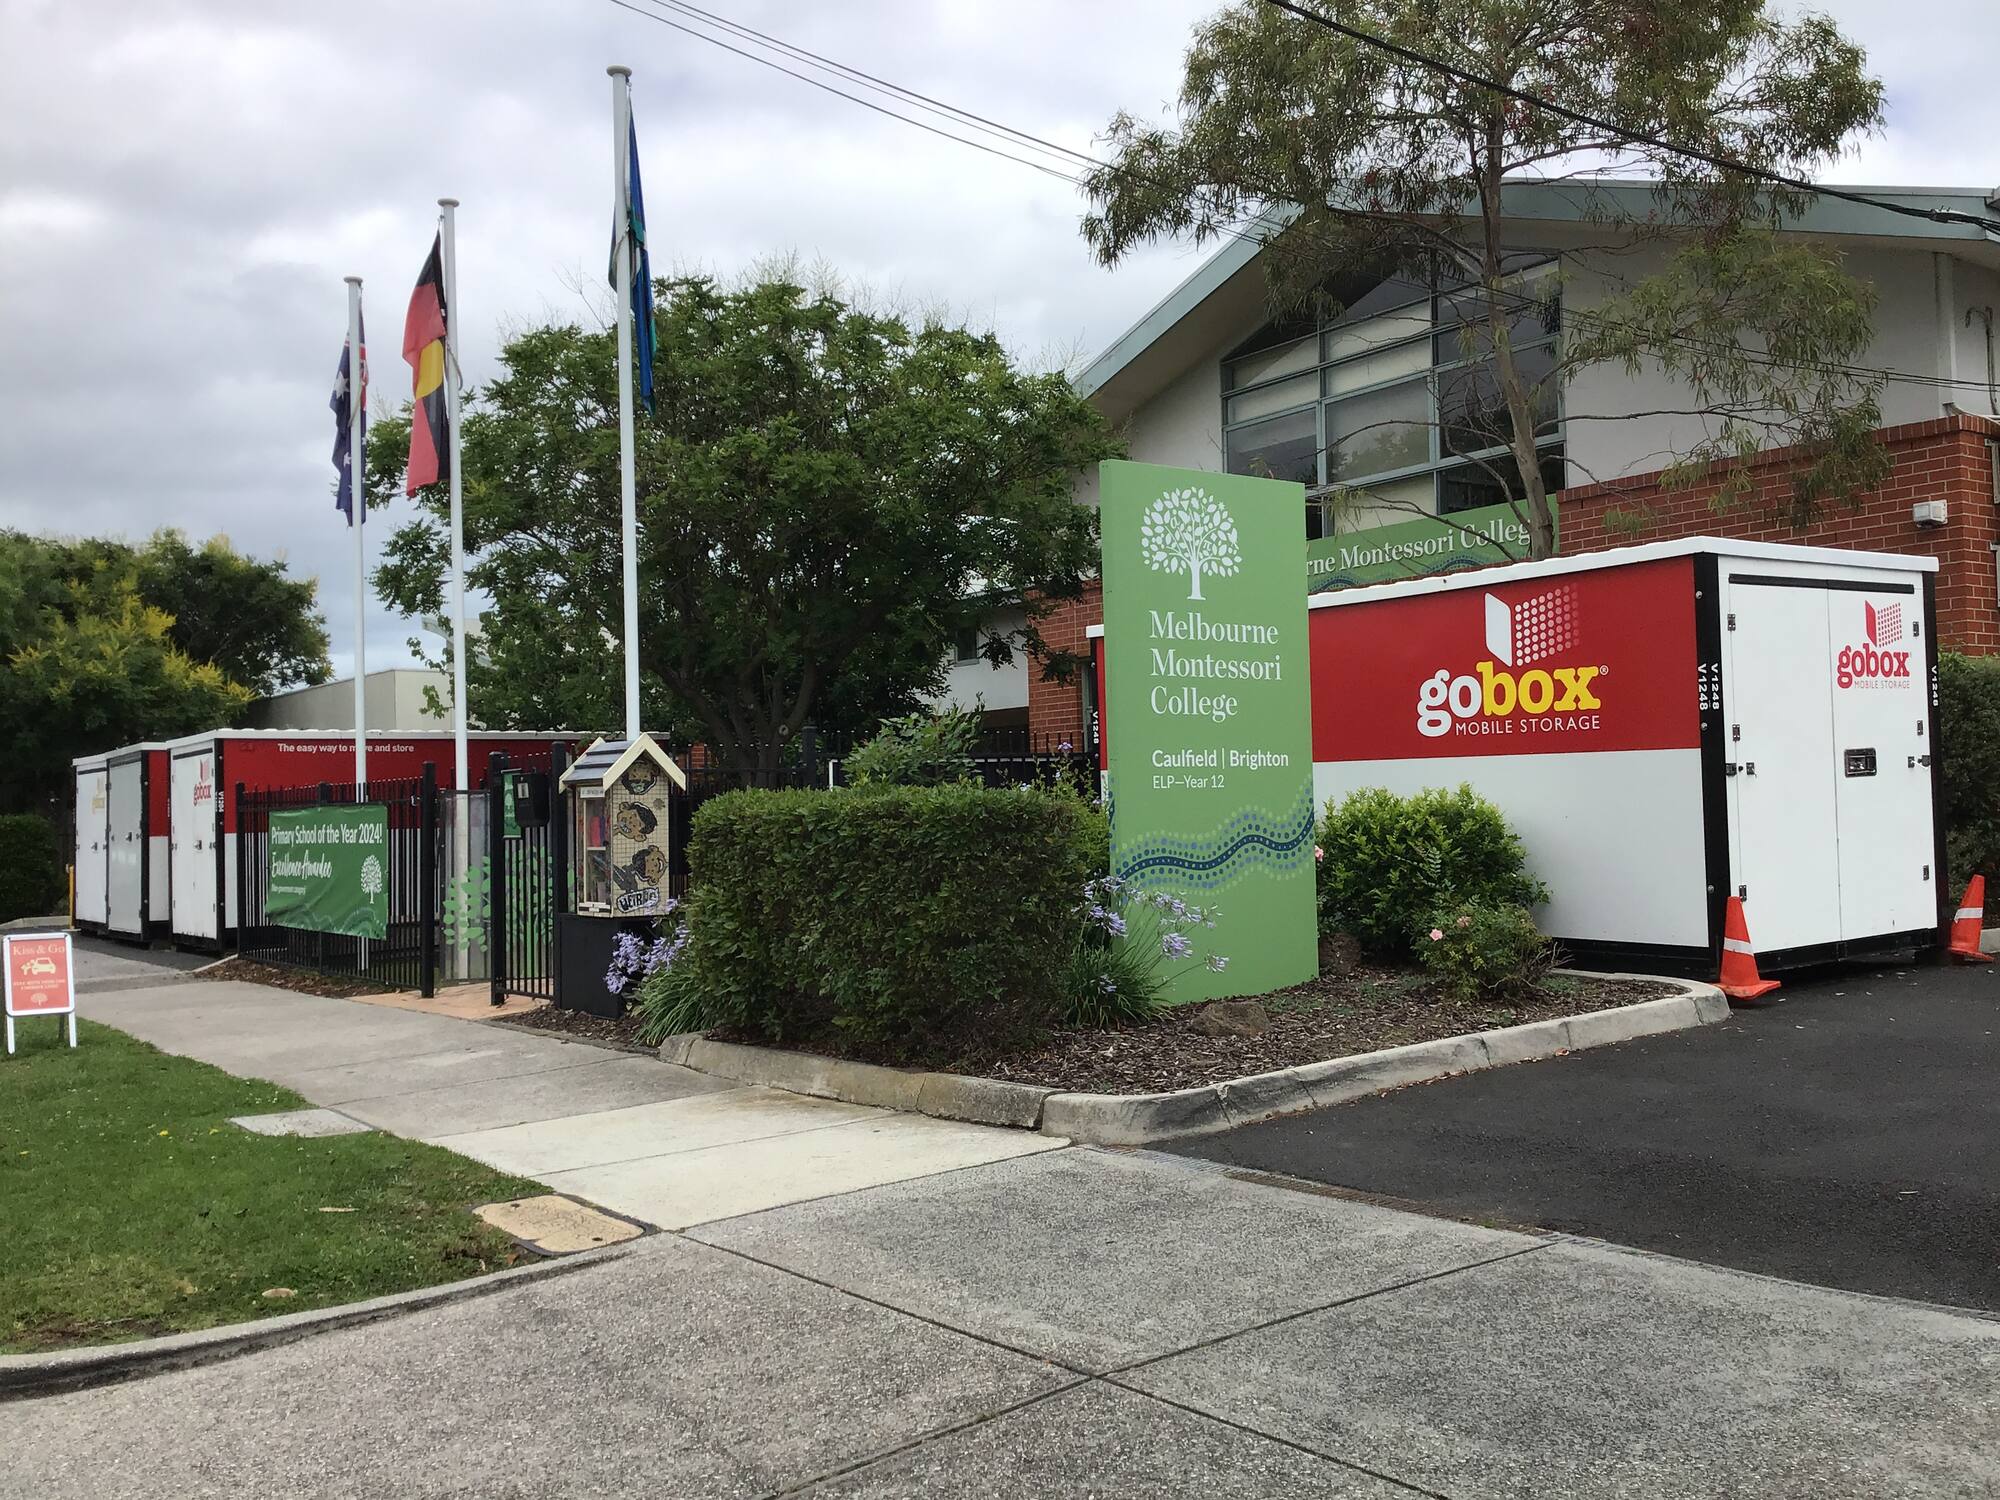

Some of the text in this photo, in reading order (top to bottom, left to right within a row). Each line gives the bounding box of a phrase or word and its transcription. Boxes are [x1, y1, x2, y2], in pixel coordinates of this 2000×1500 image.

[1339, 528, 1455, 571] Montessori
[1460, 518, 1531, 548] Colleg
[1149, 610, 1279, 644] Melbourne
[1150, 648, 1282, 680] Montessori
[1837, 643, 1910, 689] gobox
[1697, 663, 1709, 711] V1248
[1711, 662, 1720, 710] V1248
[1854, 680, 1910, 689] MOBILE STORAGE
[1931, 665, 1939, 707] V1248
[1151, 685, 1238, 723] College
[1456, 715, 1600, 736] MOBILE STORAGE
[278, 743, 295, 752] The
[296, 744, 317, 754] easy
[319, 745, 336, 754] way
[339, 743, 347, 752] to
[374, 743, 390, 752] and
[392, 743, 414, 752] store
[1152, 750, 1289, 770] Caulfield Brighton
[1211, 775, 1225, 788] 12
[271, 823, 383, 848] Primary School of the Year 2024!
